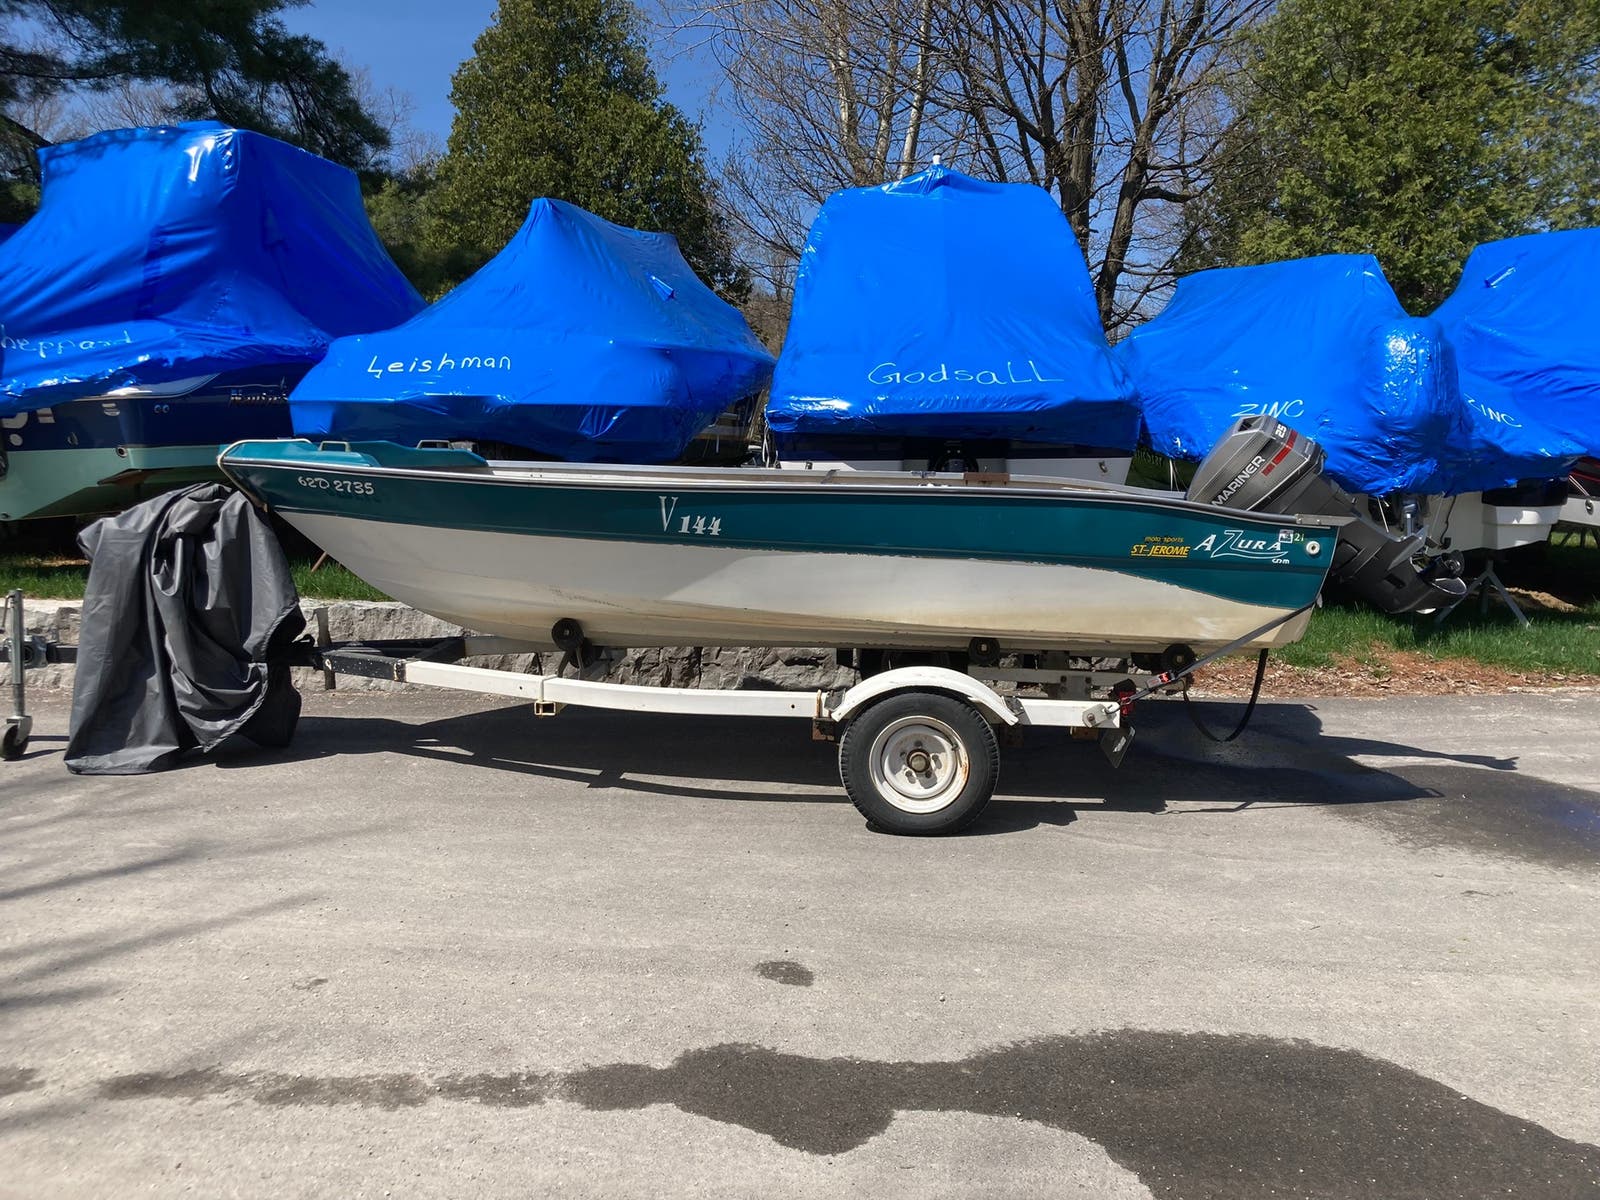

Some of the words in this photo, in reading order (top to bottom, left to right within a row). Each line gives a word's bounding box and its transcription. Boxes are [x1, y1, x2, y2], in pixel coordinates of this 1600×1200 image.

[367, 353, 512, 378] Leishman
[1231, 400, 1305, 418] ZINC
[1464, 393, 1523, 428] ZINC
[1275, 423, 1287, 438] 25
[333, 479, 375, 495] 2735
[1211, 455, 1266, 507] MARINER
[659, 495, 679, 532] V
[678, 515, 722, 536] 144
[1130, 544, 1191, 557] ST-JEROME
